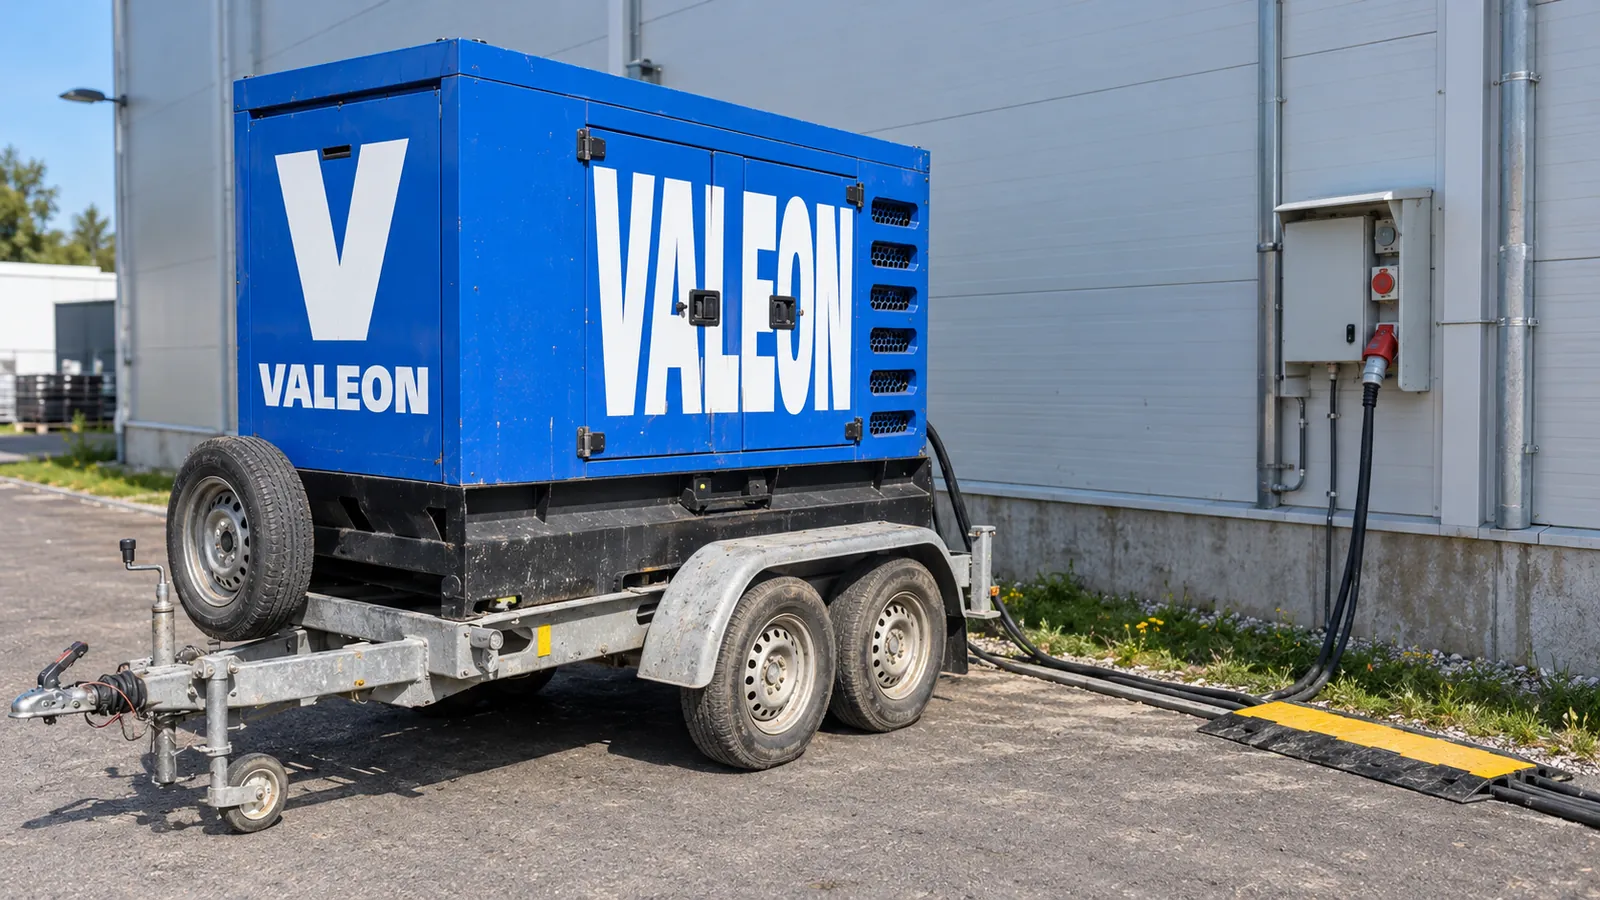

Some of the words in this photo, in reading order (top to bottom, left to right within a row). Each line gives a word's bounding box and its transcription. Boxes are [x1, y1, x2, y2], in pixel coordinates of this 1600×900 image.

[275, 138, 409, 341] V
[593, 165, 854, 417] VALEON
[258, 363, 429, 415] VALEON
